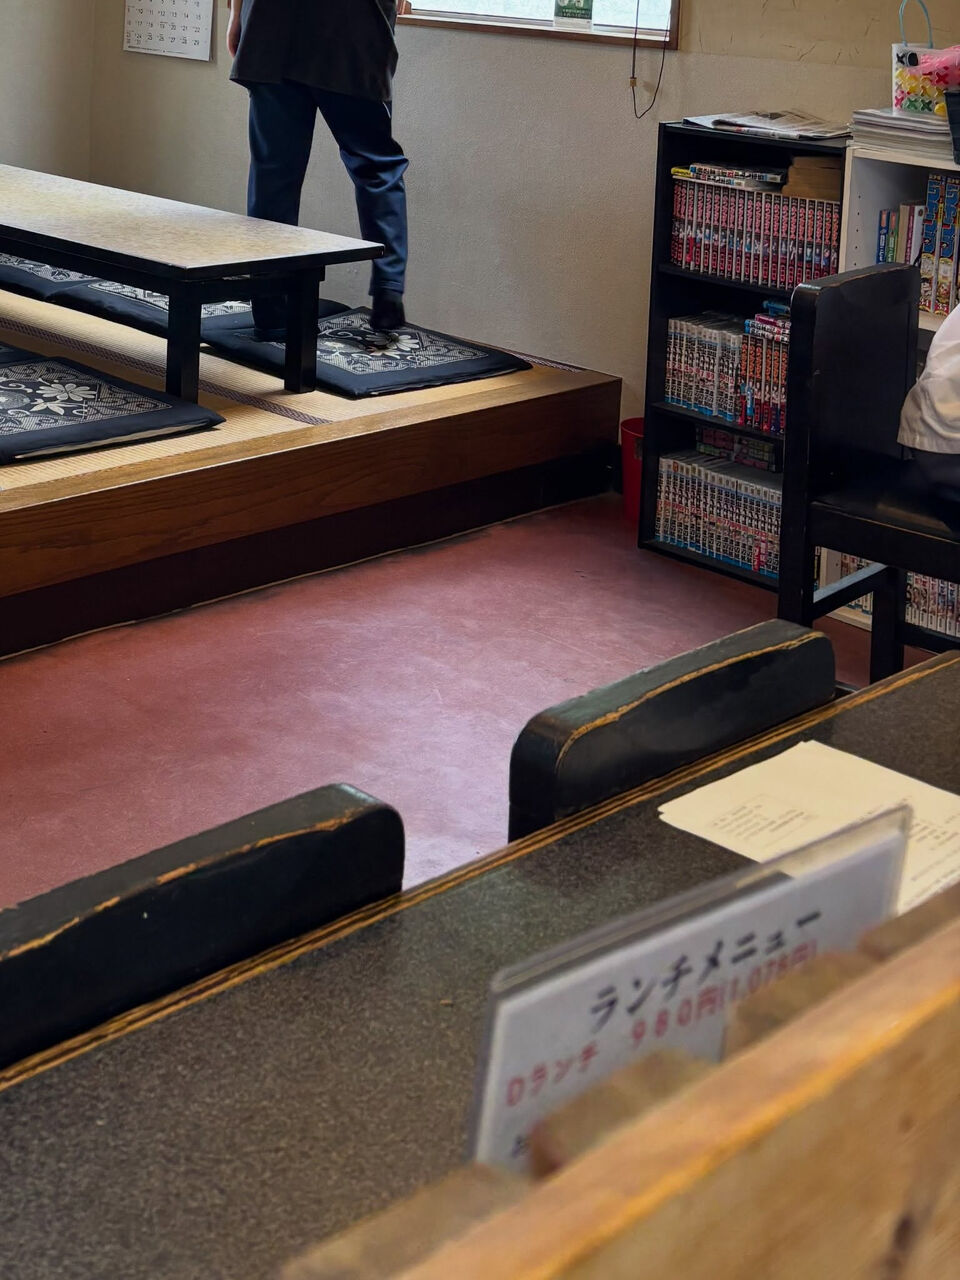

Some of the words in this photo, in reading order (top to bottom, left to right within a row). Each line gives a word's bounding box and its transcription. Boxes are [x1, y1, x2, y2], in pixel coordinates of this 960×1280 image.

[591, 910, 822, 1035] ランチメニュー
